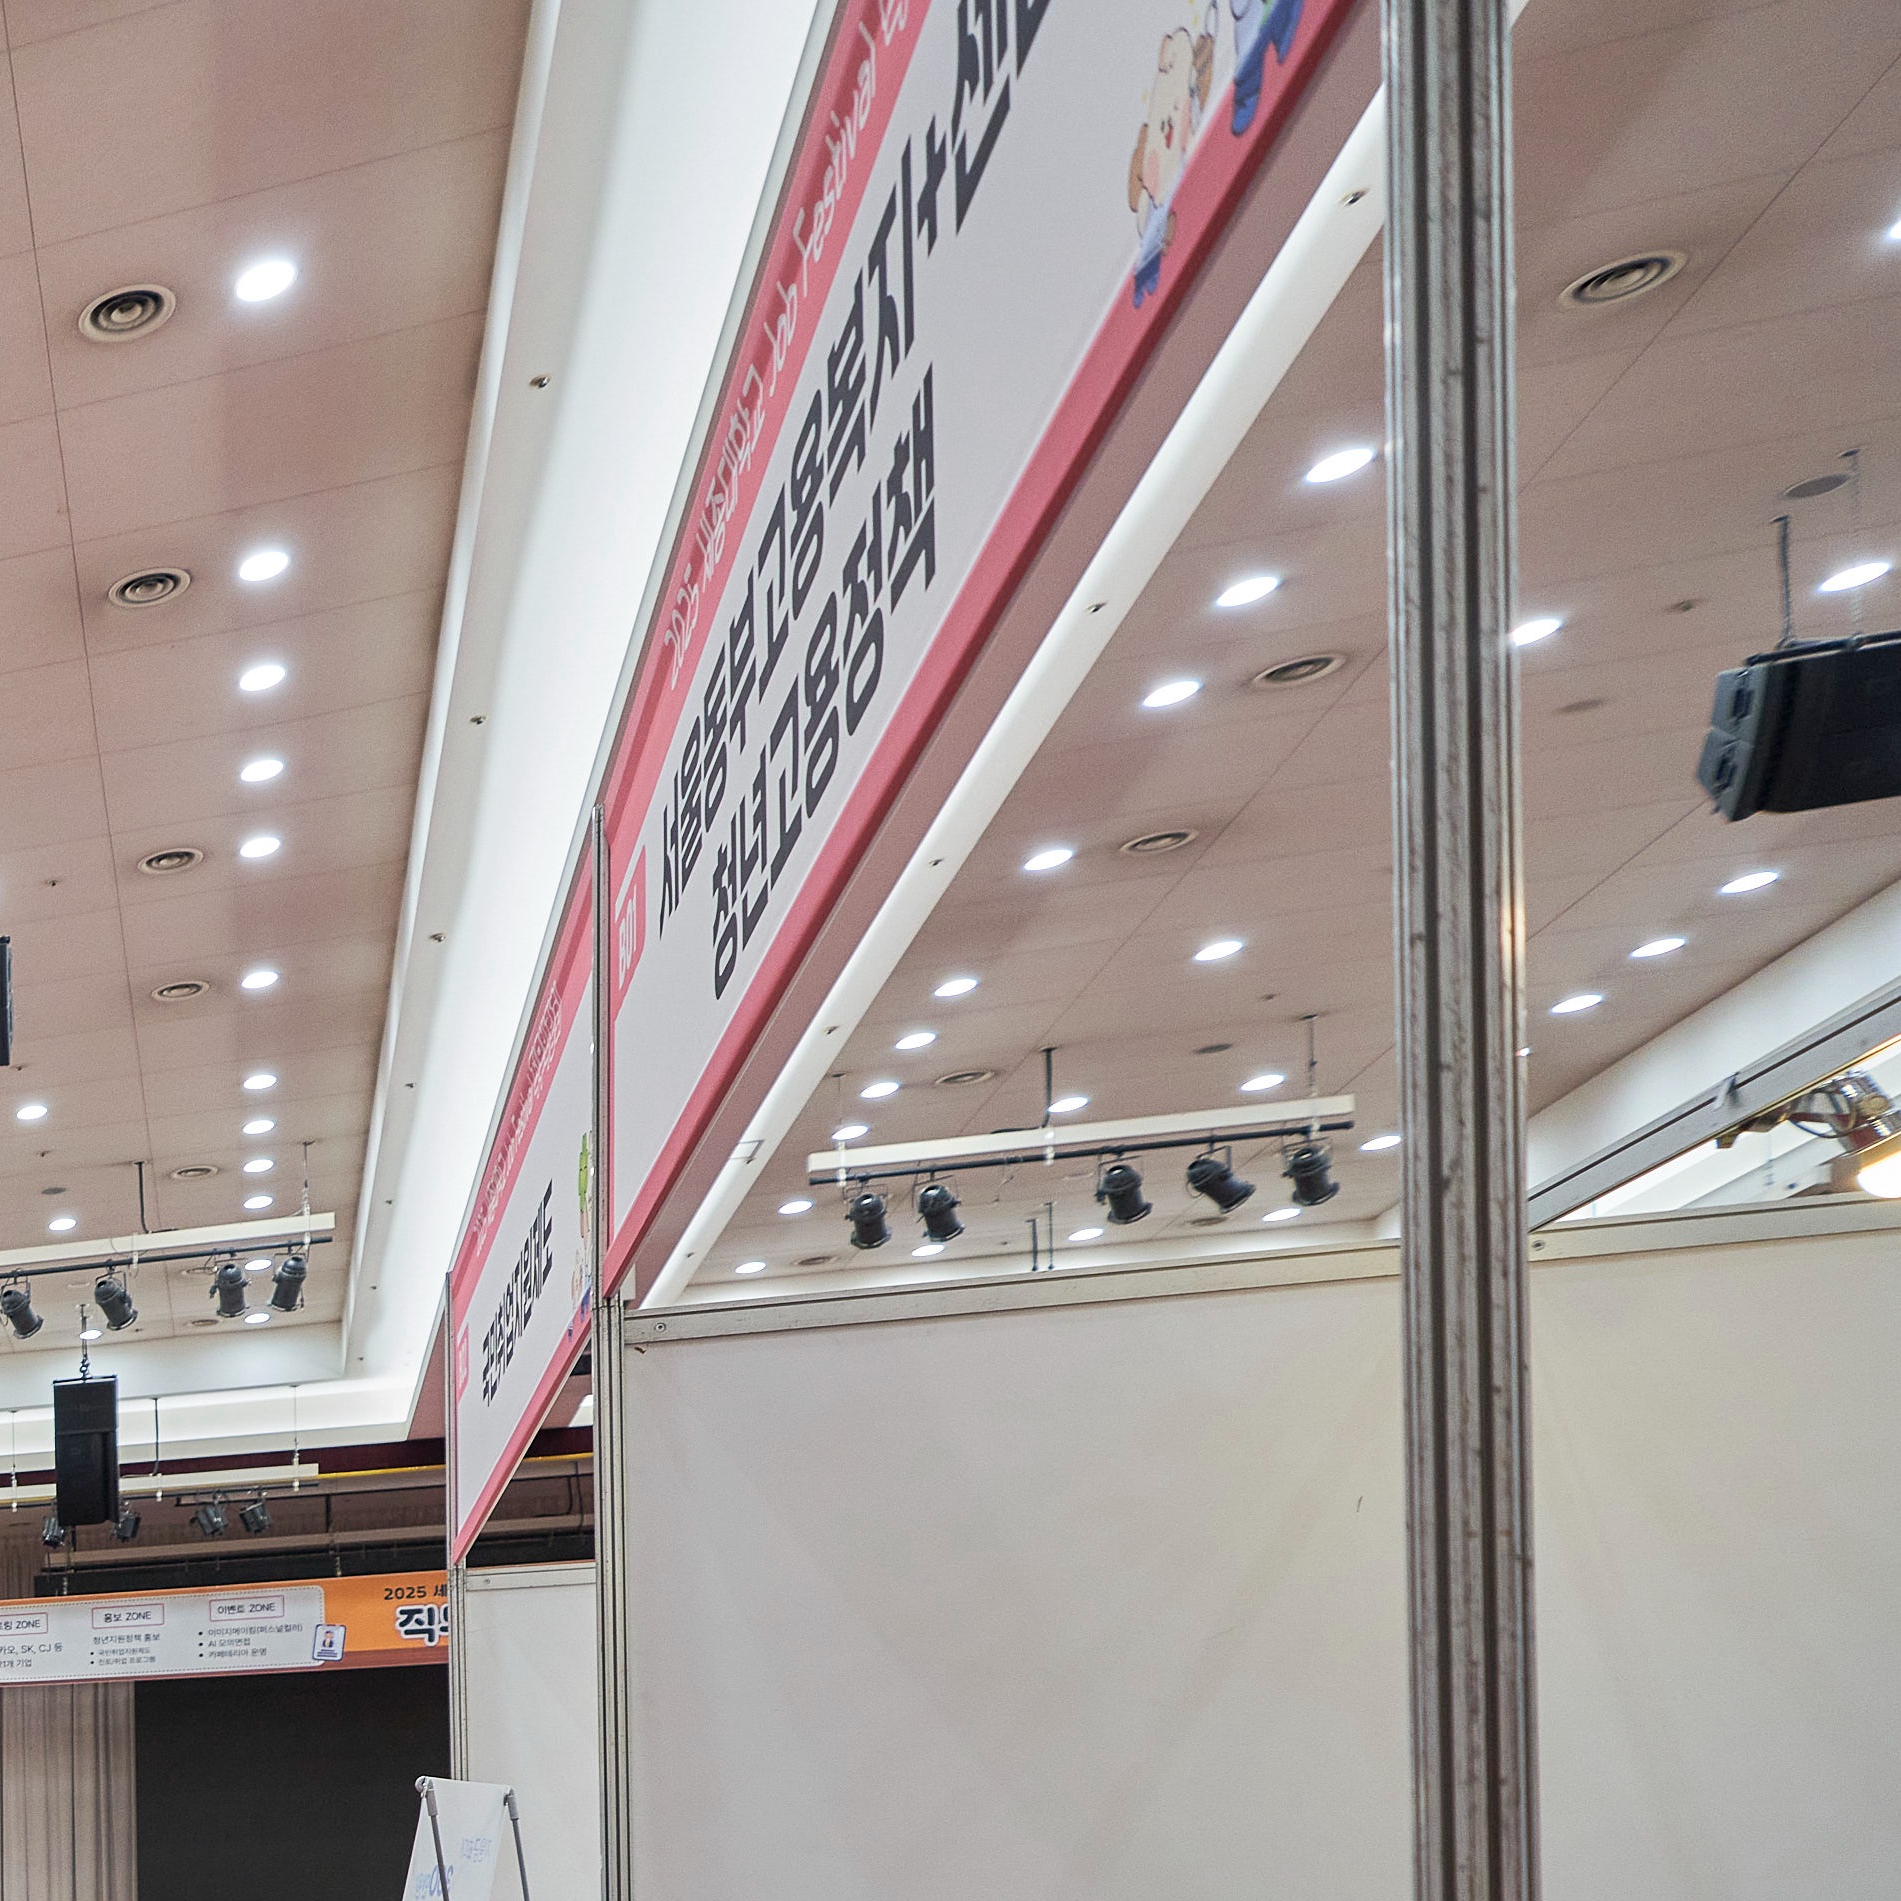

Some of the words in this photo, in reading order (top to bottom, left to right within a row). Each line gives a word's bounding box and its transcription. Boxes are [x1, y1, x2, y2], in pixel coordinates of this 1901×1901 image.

[664, 562, 699, 690] 2025
[696, 365, 766, 591] 세종대학교
[764, 280, 798, 397] Job
[793, 21, 875, 298] Festival
[660, 0, 1049, 939] 서울동부고용복지+센
[713, 360, 935, 1000] 청년고용정책
[618, 884, 638, 991] B01
[482, 1178, 554, 1406] 국민취업지원제도
[384, 1585, 427, 1601] 2025
[217, 1604, 245, 1615] 이벤트
[249, 1602, 276, 1613] ZONE
[103, 1612, 122, 1624] 홍보
[125, 1611, 152, 1621] ZONE
[15, 1620, 41, 1629] ZONE
[398, 1604, 448, 1647] 직
[93, 1634, 142, 1645] 청년지원정책
[144, 1632, 161, 1642] 홍보
[208, 1640, 217, 1648] AI
[218, 1638, 251, 1647] 모의면접
[21, 1645, 36, 1655] SK,
[38, 1644, 52, 1653] CJ
[208, 1648, 249, 1658] 카페테리아
[251, 1647, 267, 1657] 운영
[16, 1658, 32, 1668] 기업
